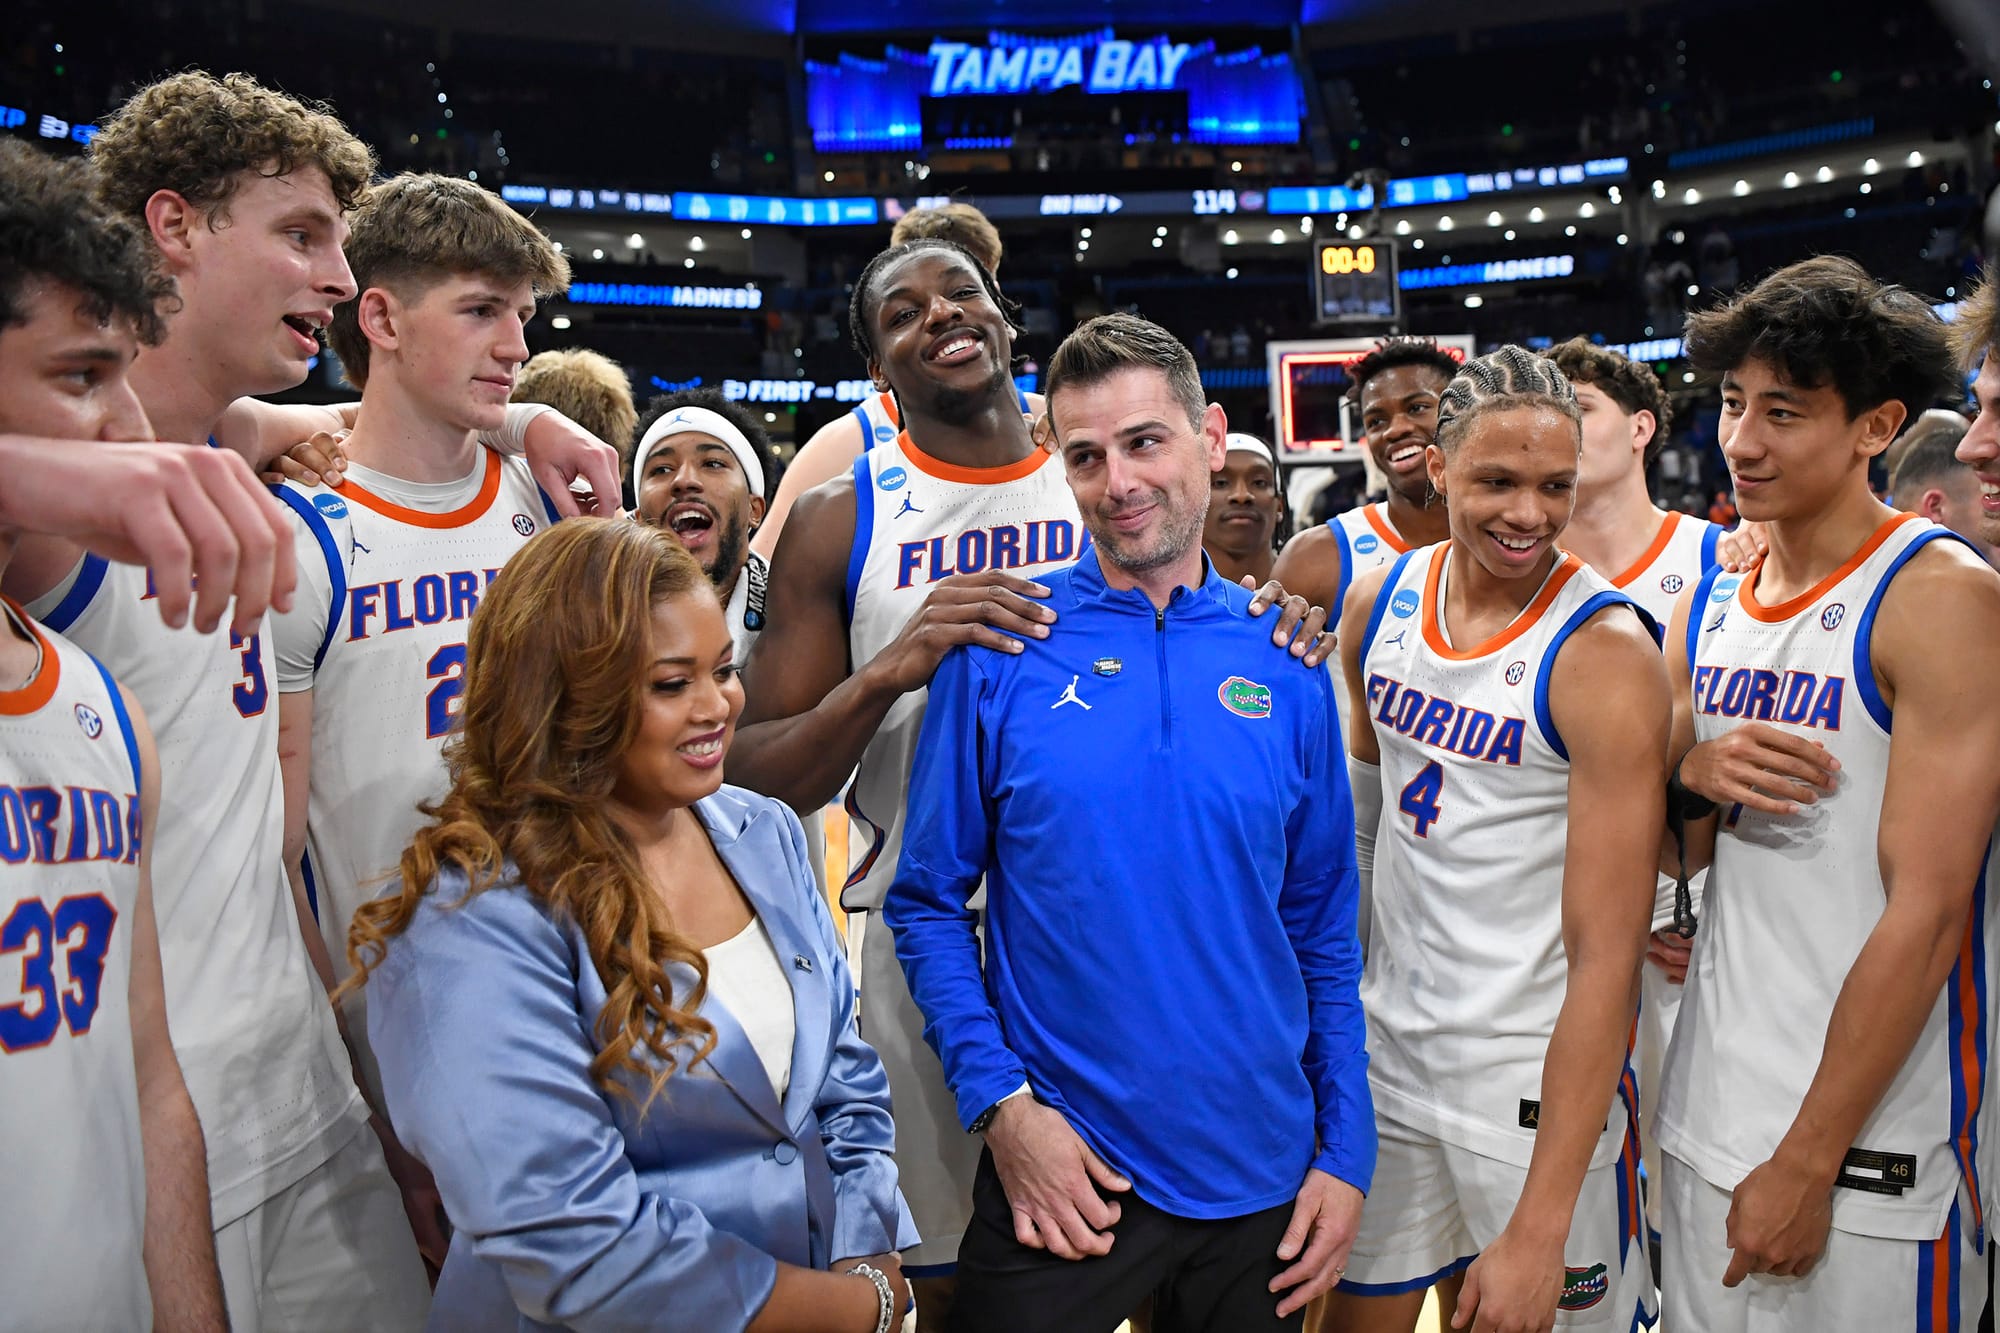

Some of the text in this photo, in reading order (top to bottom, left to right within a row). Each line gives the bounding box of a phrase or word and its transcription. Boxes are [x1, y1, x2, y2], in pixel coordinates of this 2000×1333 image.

[928, 40, 1191, 97] TAMPA BAY
[747, 379, 816, 402] FIRST
[882, 473, 906, 487] NCAA
[321, 502, 345, 514] NCAA
[513, 514, 534, 535] SEC
[1662, 575, 1682, 593] SEC
[1393, 599, 1416, 613] NCAA
[1823, 604, 1844, 630] SEC
[230, 616, 269, 719] 3
[1506, 662, 1525, 685] SEC
[1694, 665, 1846, 732] FLORIDA
[1366, 671, 1527, 767] FLORIDA
[1399, 758, 1445, 839] 4
[0, 891, 118, 1055] 33
[1890, 1163, 1909, 1177] 46
